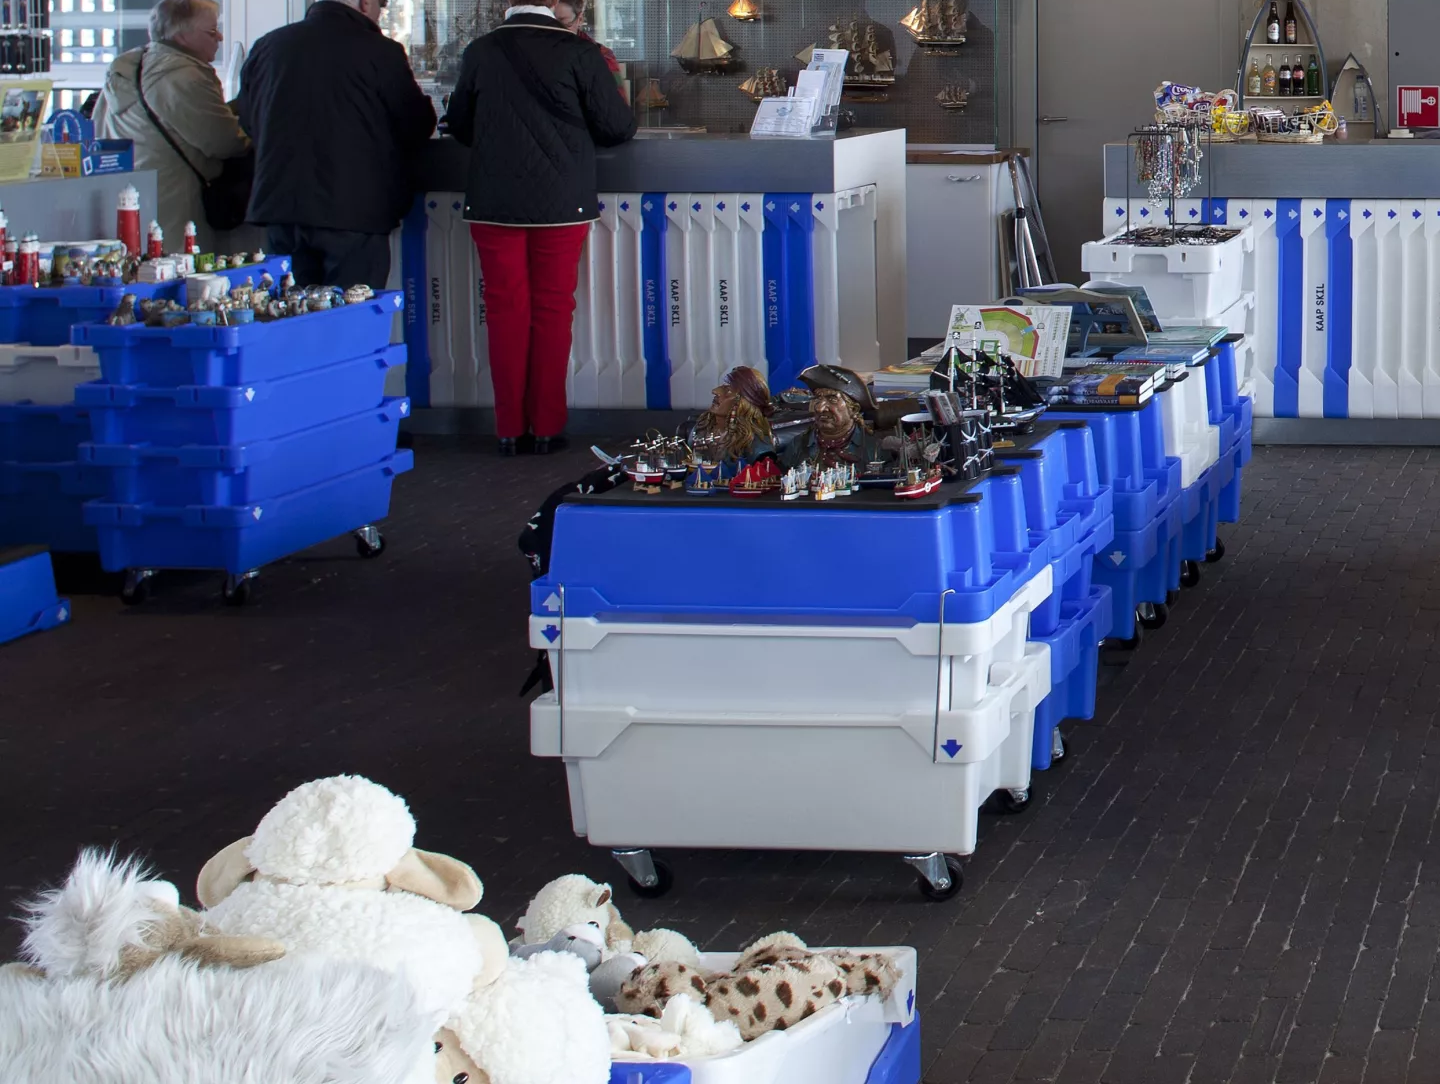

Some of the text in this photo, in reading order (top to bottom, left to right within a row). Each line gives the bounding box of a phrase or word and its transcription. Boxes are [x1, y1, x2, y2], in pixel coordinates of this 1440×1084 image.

[646, 279, 656, 327] KAAP SKIL
[671, 279, 680, 327] KAAP SKIL
[719, 279, 729, 327] KAAP SKIL
[768, 279, 778, 328] KAAP SKIL
[1315, 283, 1325, 332] KAAP SKIL
